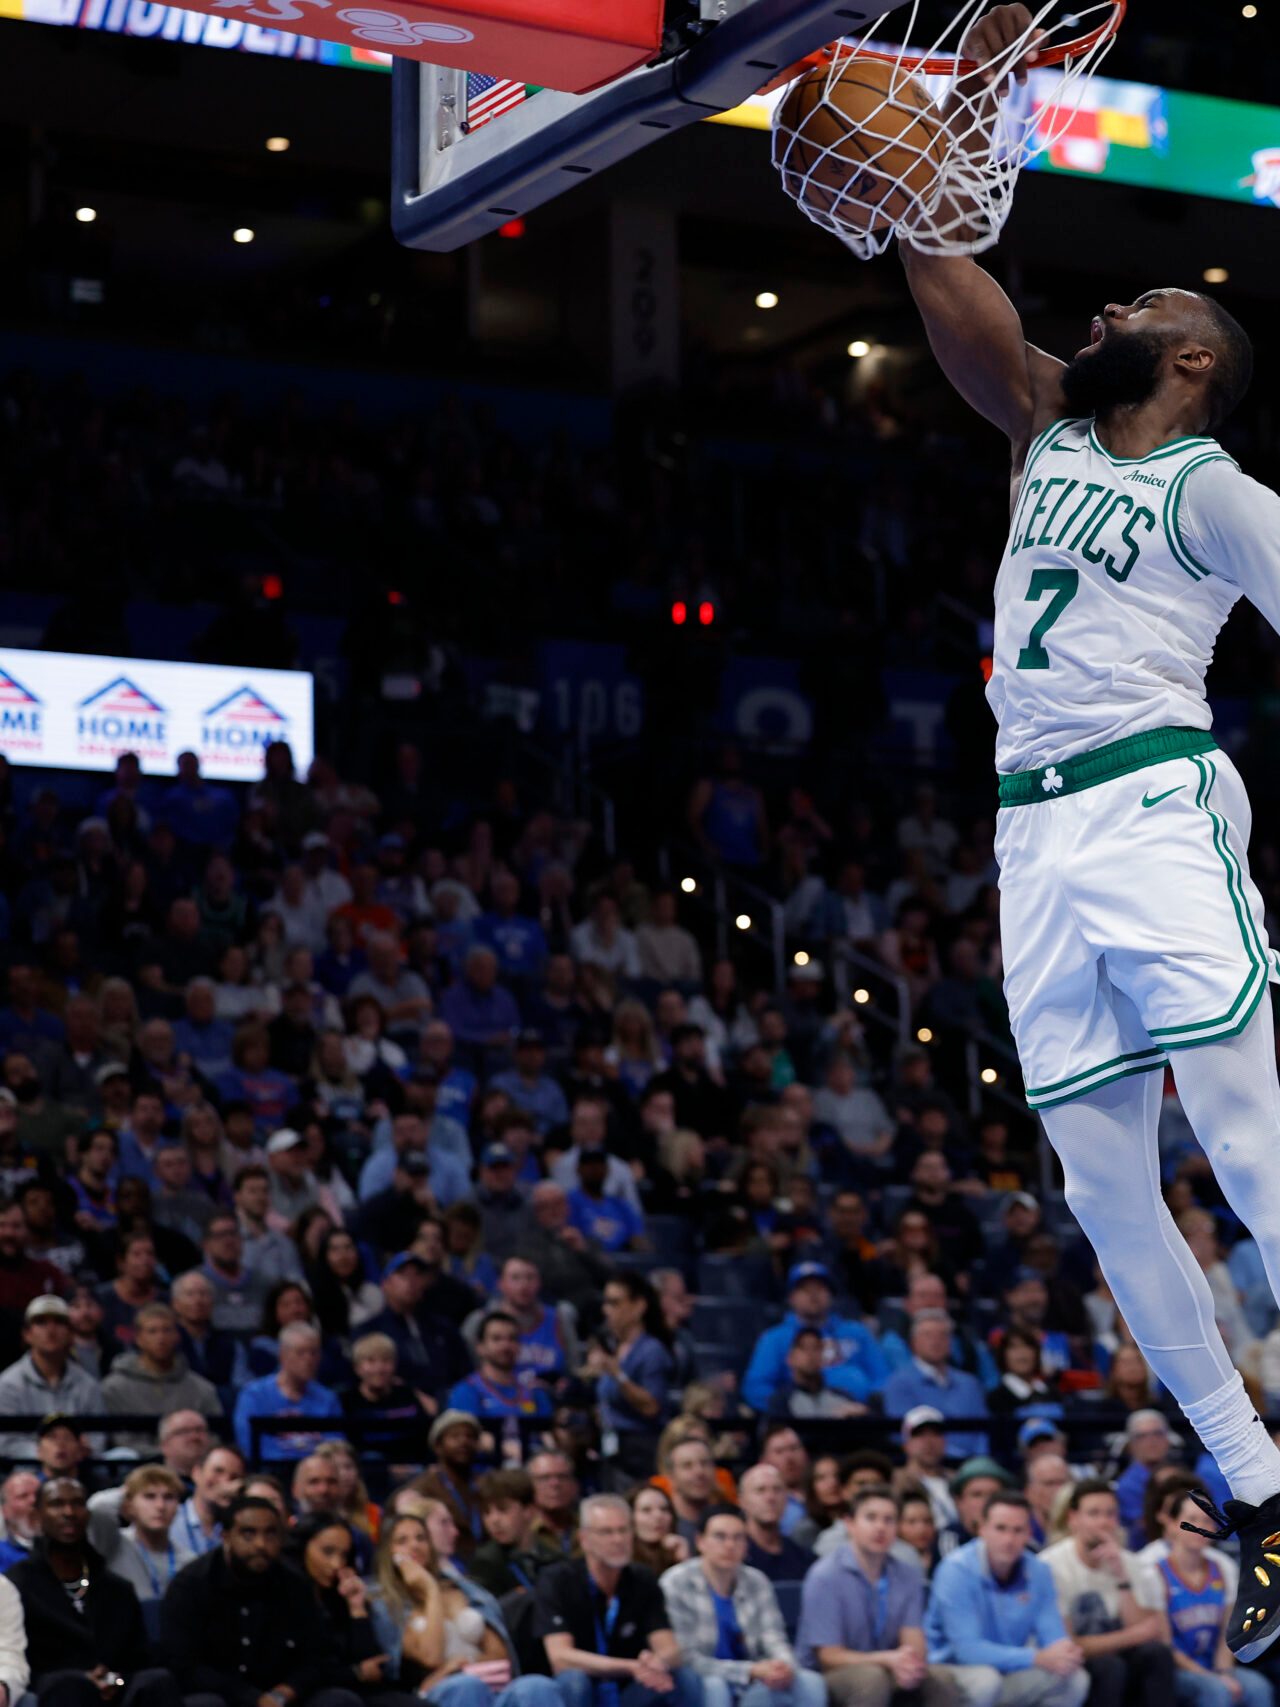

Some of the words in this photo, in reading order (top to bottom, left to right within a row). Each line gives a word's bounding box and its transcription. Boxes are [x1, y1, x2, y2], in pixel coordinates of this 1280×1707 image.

[1123, 470, 1167, 489] Amica
[1011, 478, 1156, 583] CELTICS
[1016, 568, 1079, 669] 7
[77, 716, 166, 741] HOME
